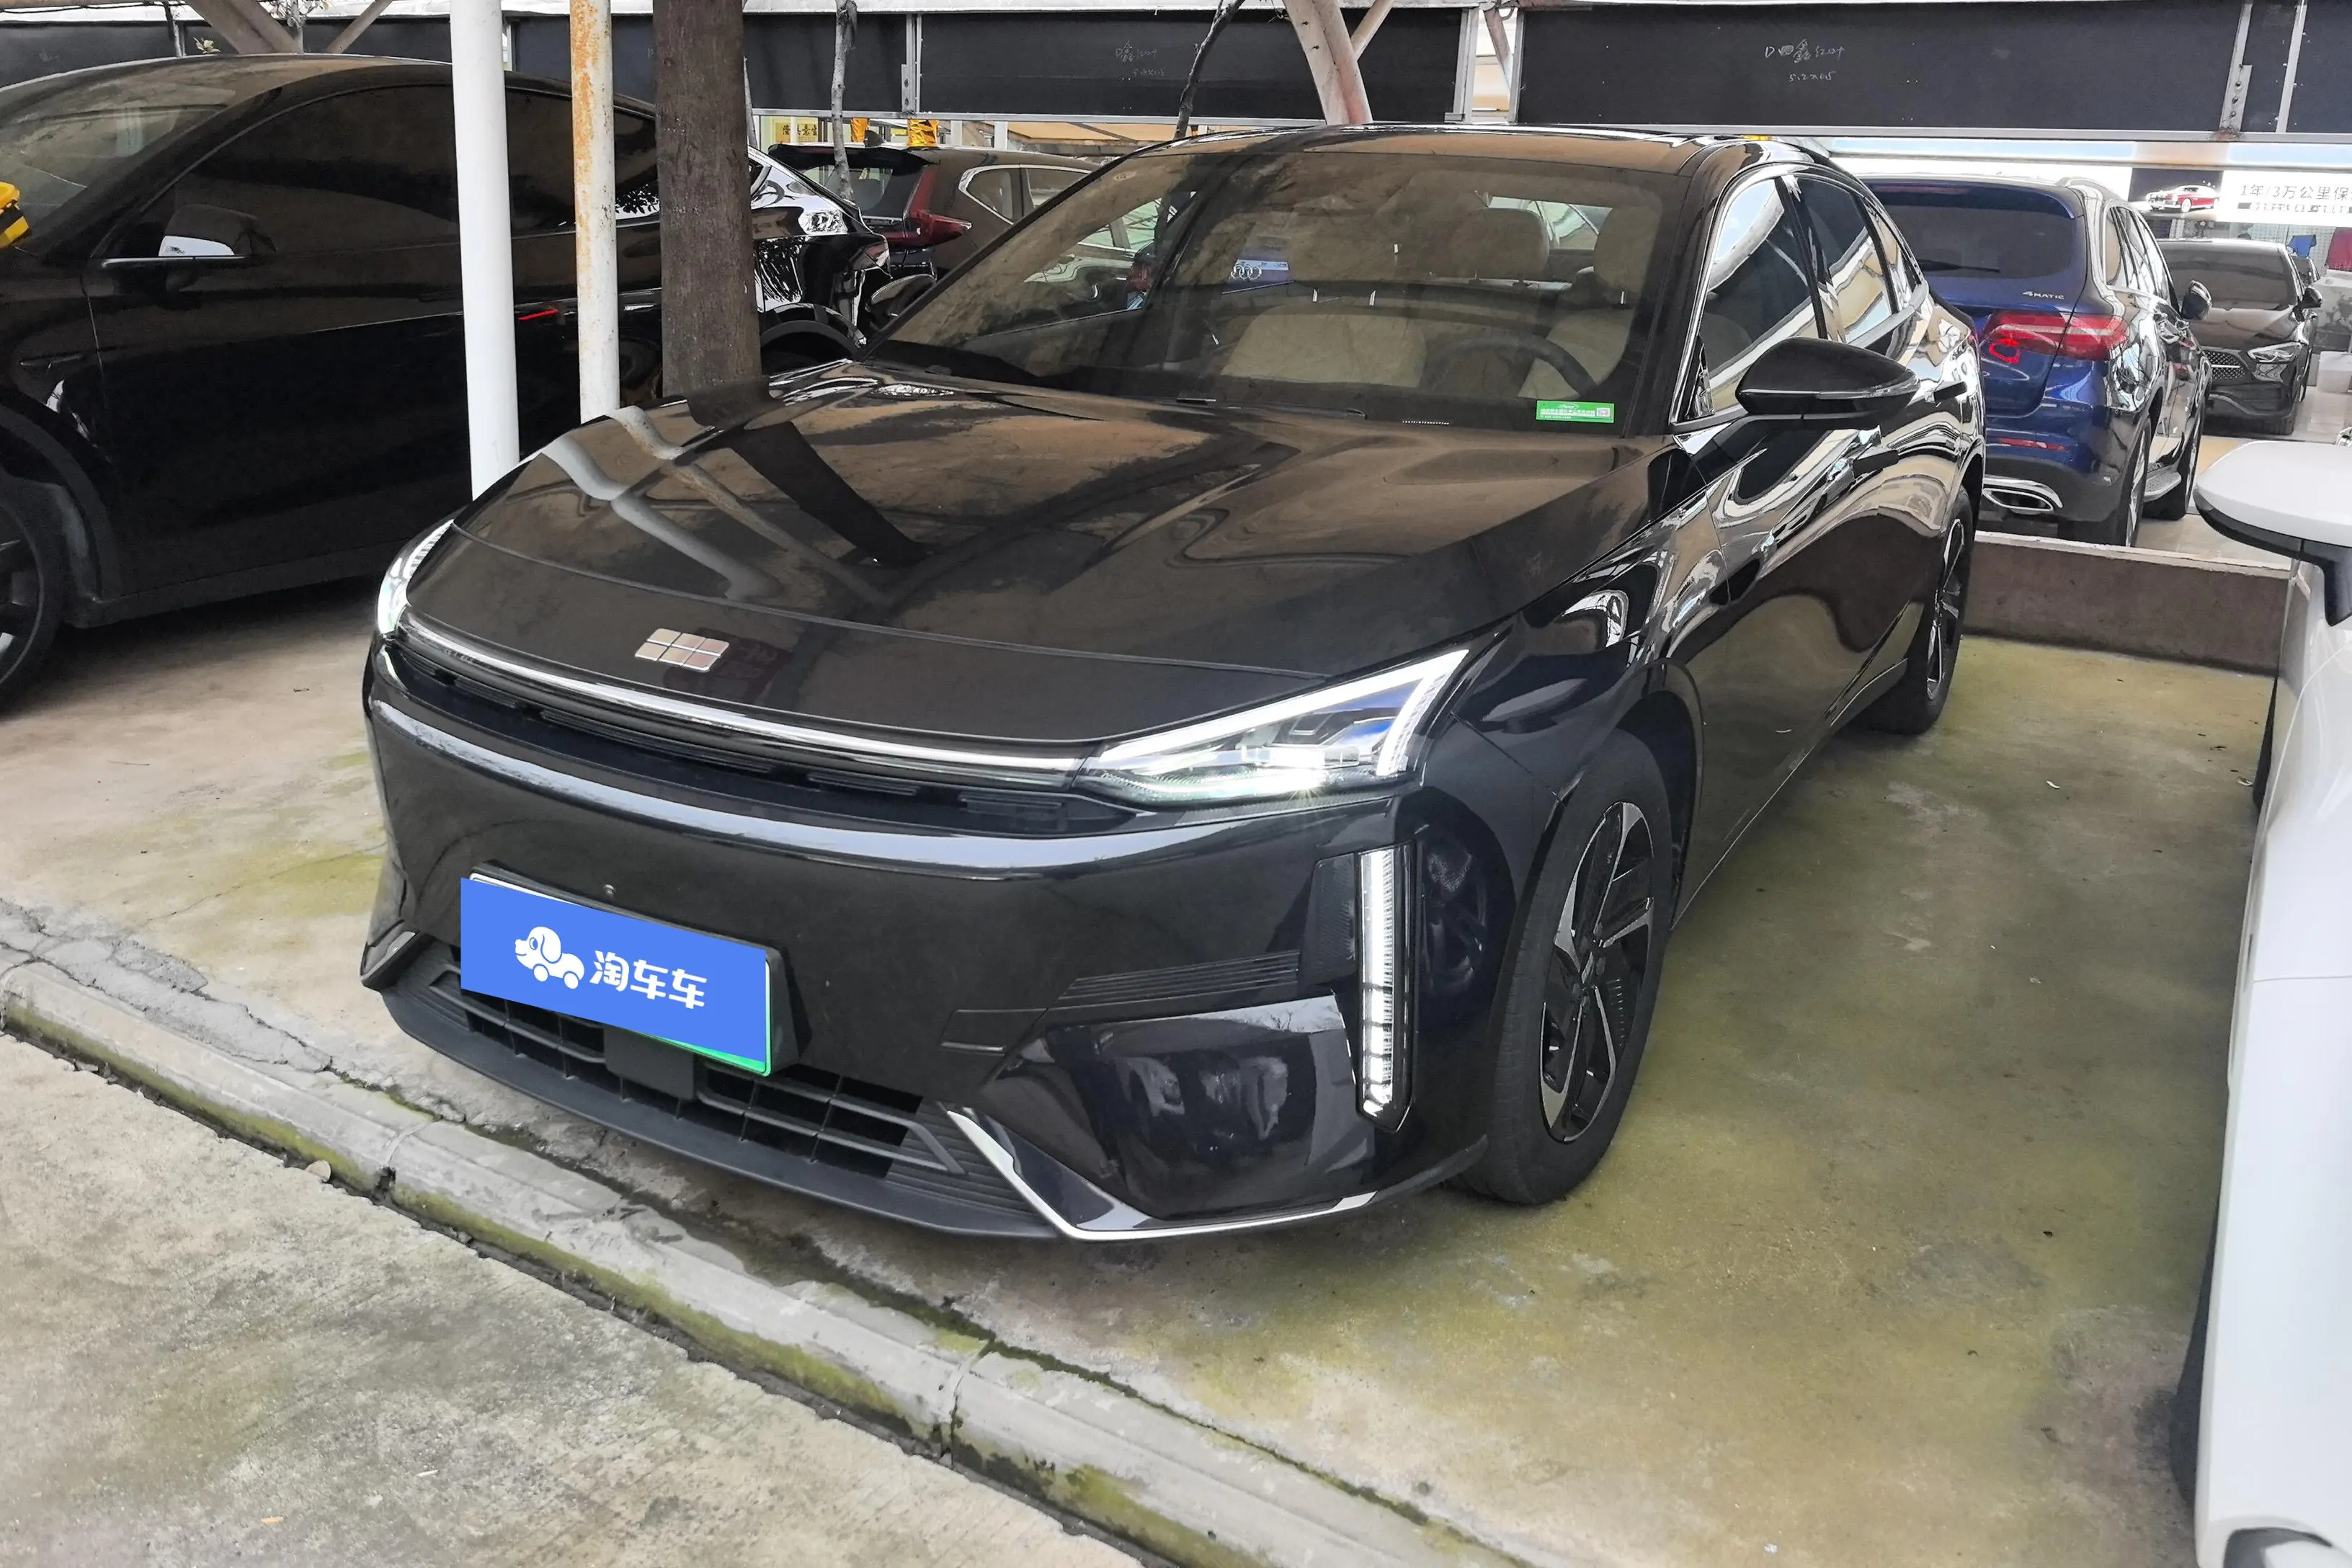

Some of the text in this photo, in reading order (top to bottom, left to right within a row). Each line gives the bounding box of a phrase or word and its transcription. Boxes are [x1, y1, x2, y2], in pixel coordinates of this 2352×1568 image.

[2240, 184, 2352, 201] 1年/3万公里保
[2023, 291, 2064, 300] 4MATIC
